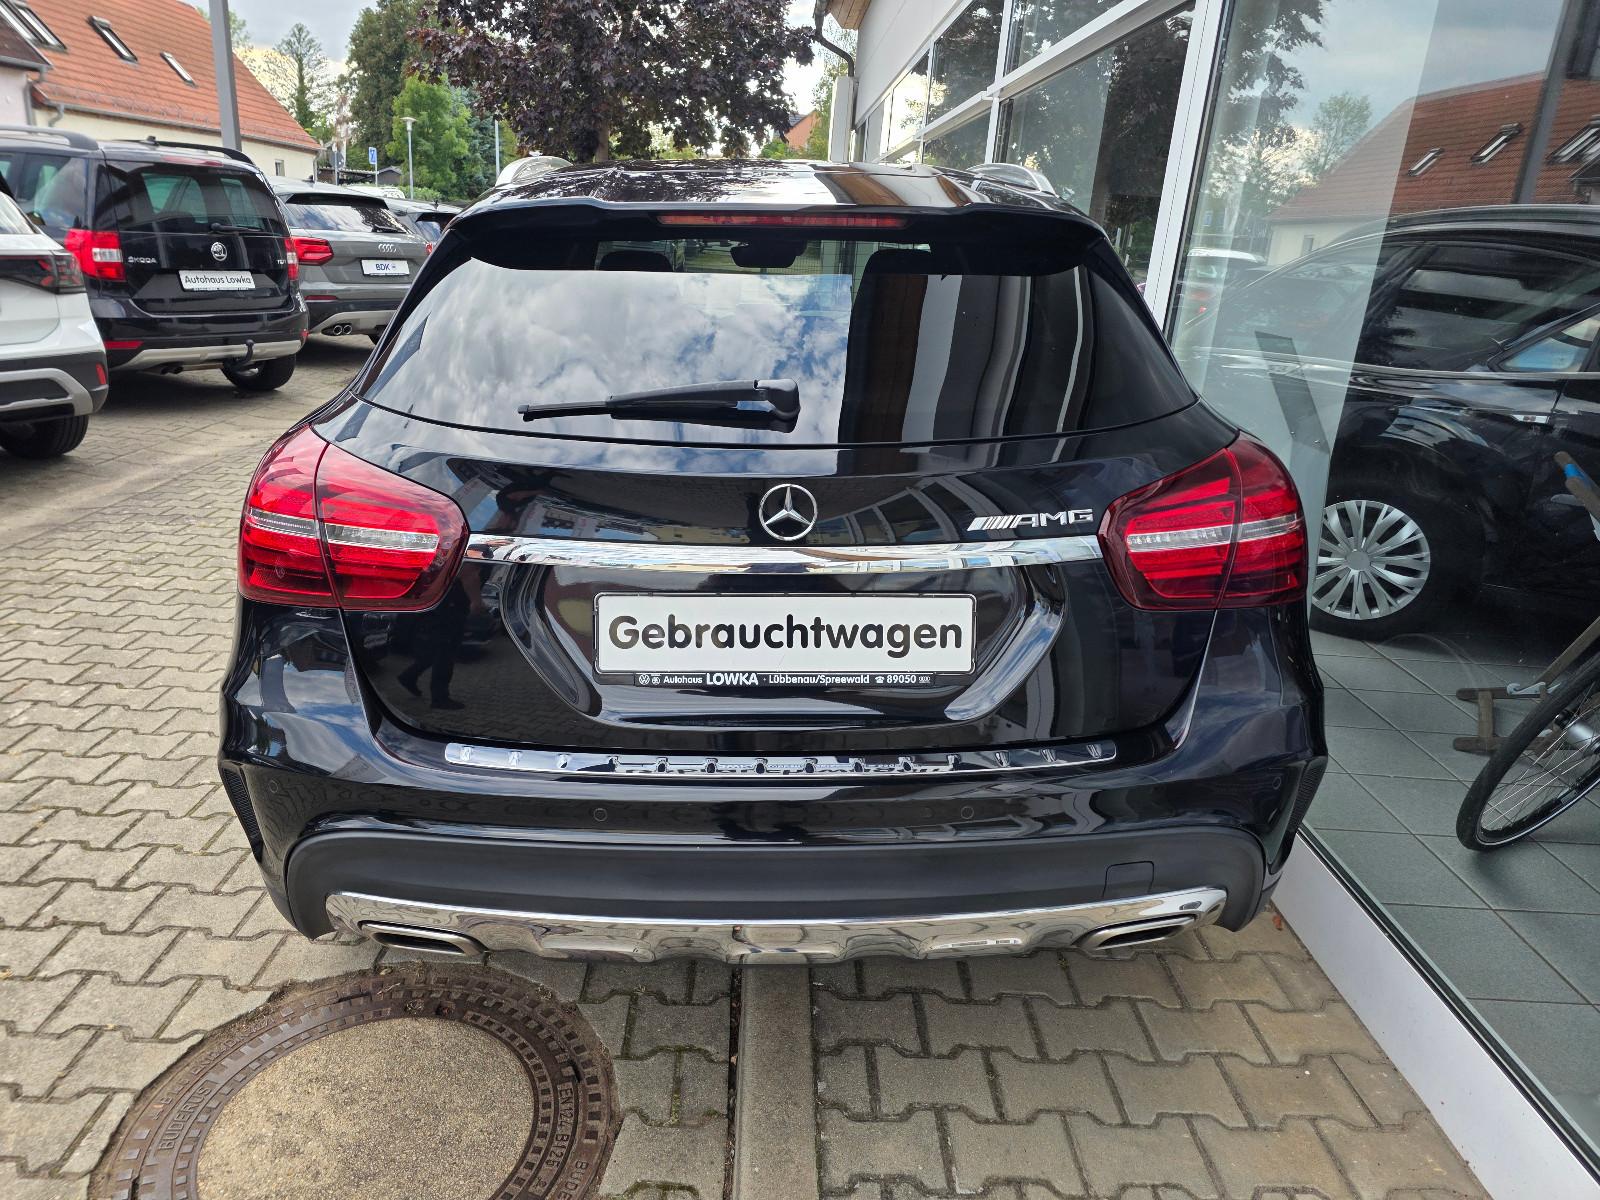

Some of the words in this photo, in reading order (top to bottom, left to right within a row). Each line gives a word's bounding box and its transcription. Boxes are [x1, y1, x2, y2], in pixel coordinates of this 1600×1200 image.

[375, 263, 391, 271] BDK
[185, 275, 225, 284] Autohaus
[226, 275, 252, 284] Lowka
[1010, 508, 1094, 528] AMG
[609, 614, 962, 659] Gebrauchtwagen
[663, 675, 703, 684] Autohaus
[706, 672, 759, 686] LOWKA
[769, 674, 870, 686] Lübbenau/Spreewald
[886, 674, 917, 684] 89050
[158, 1086, 212, 1151] BUDERUS
